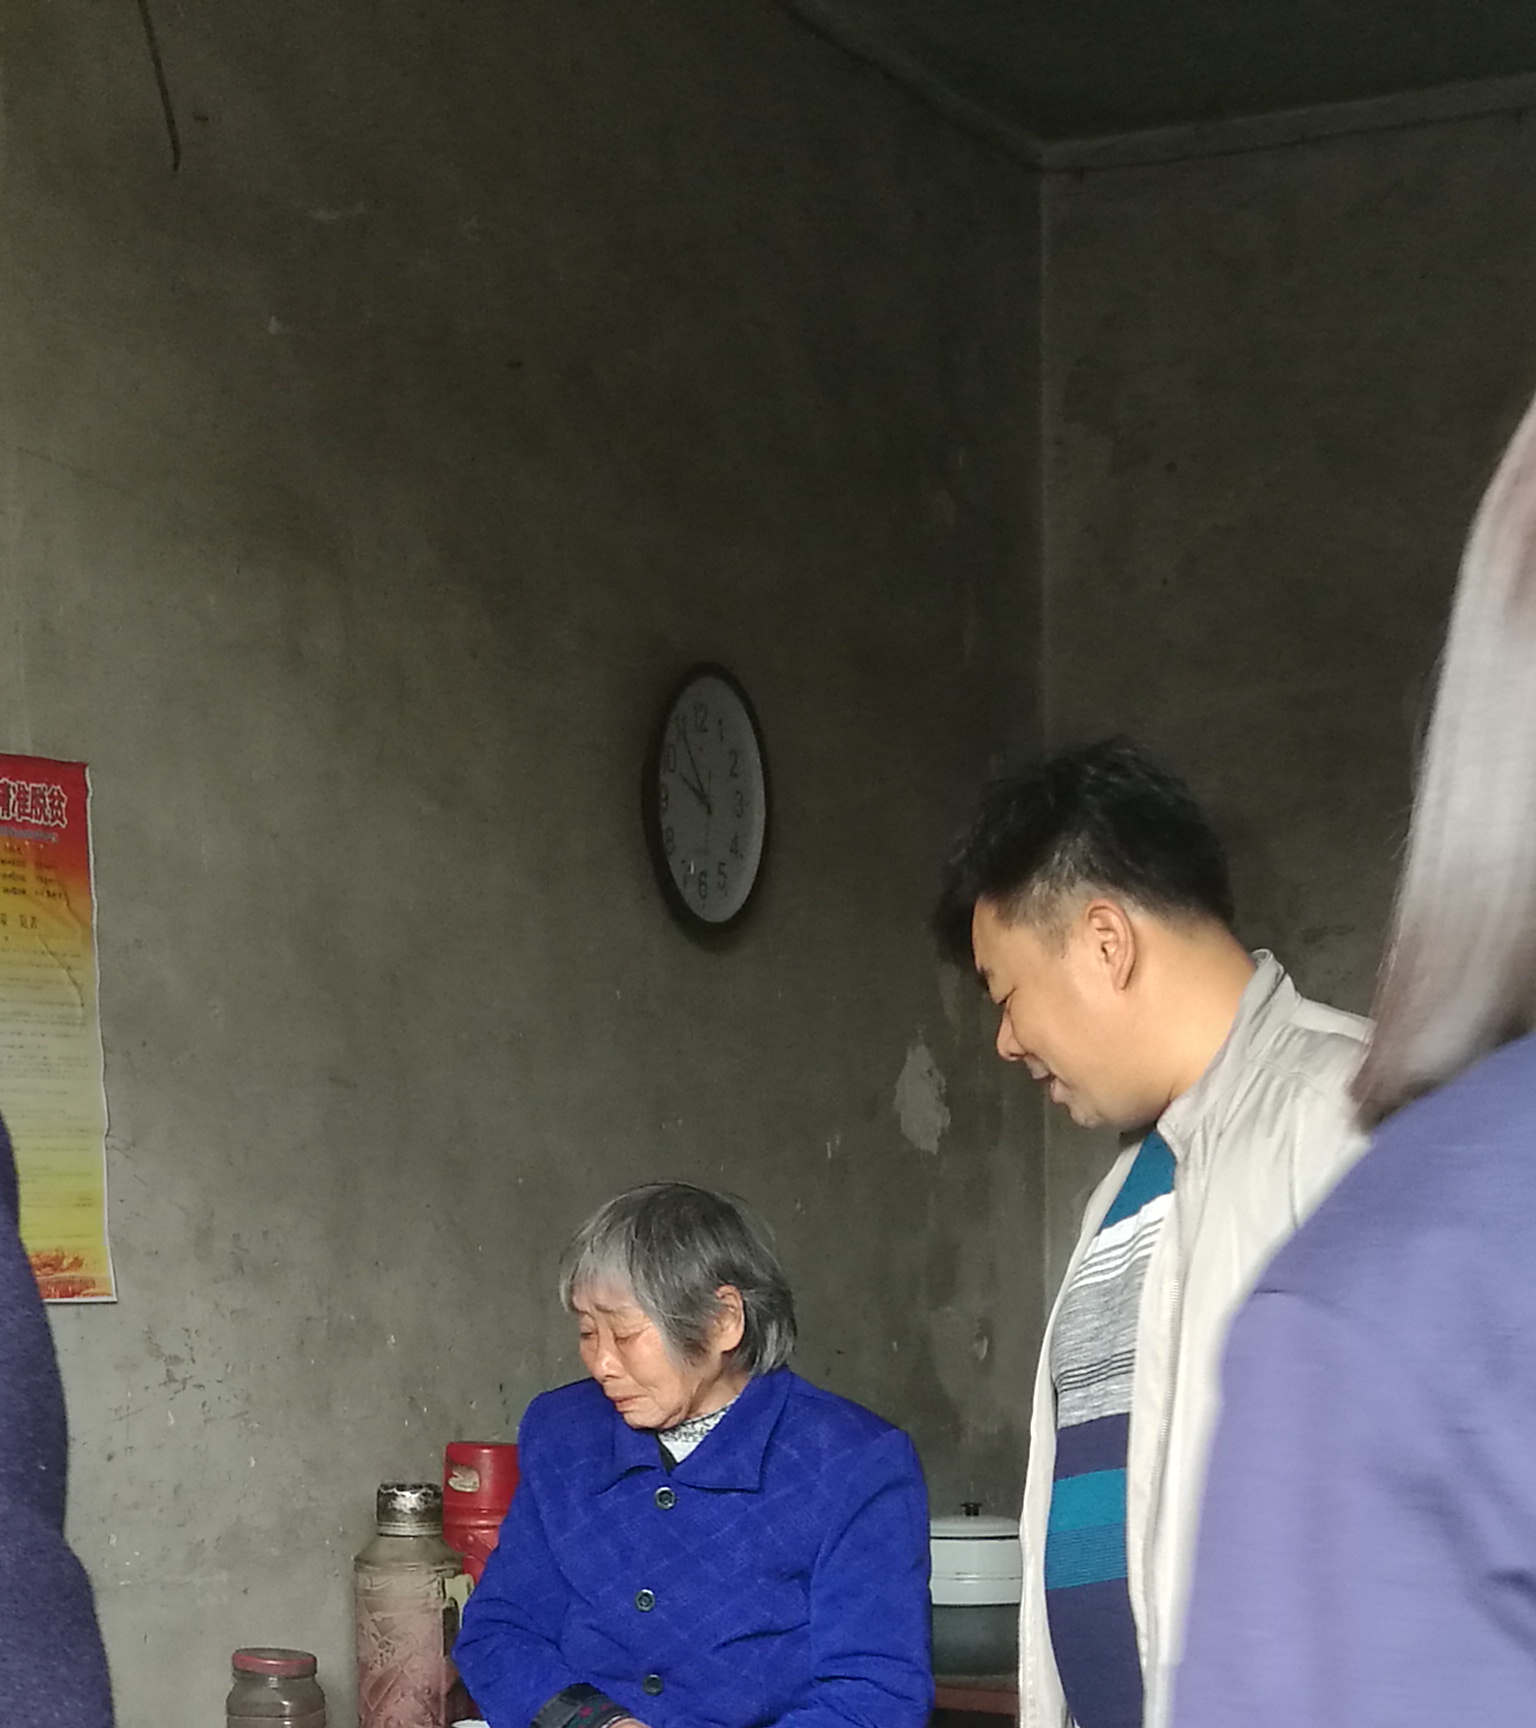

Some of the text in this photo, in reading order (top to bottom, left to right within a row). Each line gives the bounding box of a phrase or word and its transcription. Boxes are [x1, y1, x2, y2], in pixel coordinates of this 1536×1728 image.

[694, 703, 709, 733] 12
[662, 744, 677, 775] 10
[728, 749, 739, 778] 2
[665, 826, 675, 856] 8
[729, 832, 739, 858] 4
[698, 871, 708, 900] 6
[717, 862, 727, 890] 5
